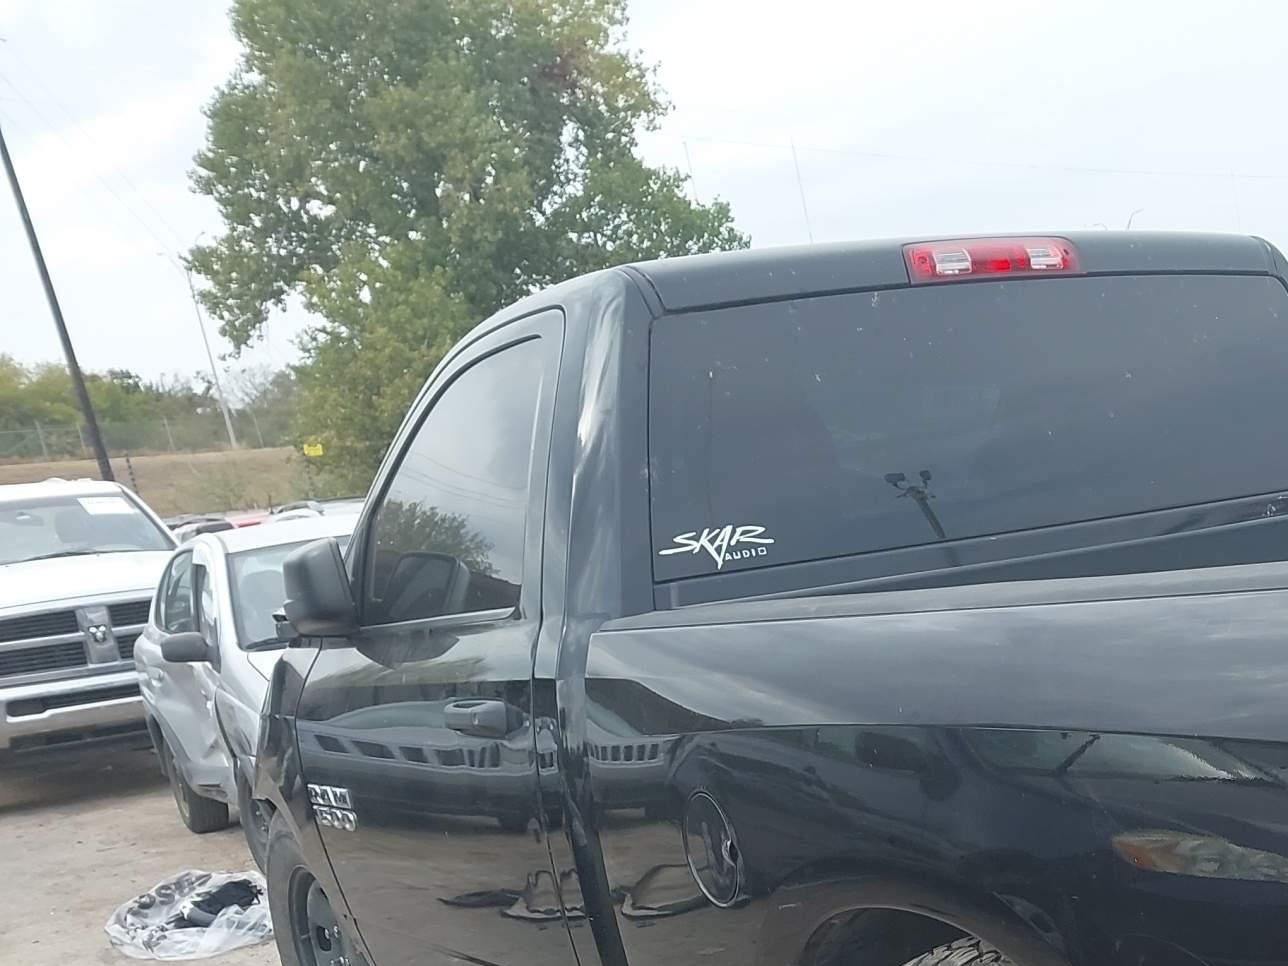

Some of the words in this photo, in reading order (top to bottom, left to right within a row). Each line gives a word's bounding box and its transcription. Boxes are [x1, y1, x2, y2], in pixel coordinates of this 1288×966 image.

[658, 524, 775, 570] SKAR
[725, 546, 767, 561] AUDIO
[307, 783, 352, 809] RAM
[312, 805, 357, 832] 1500
